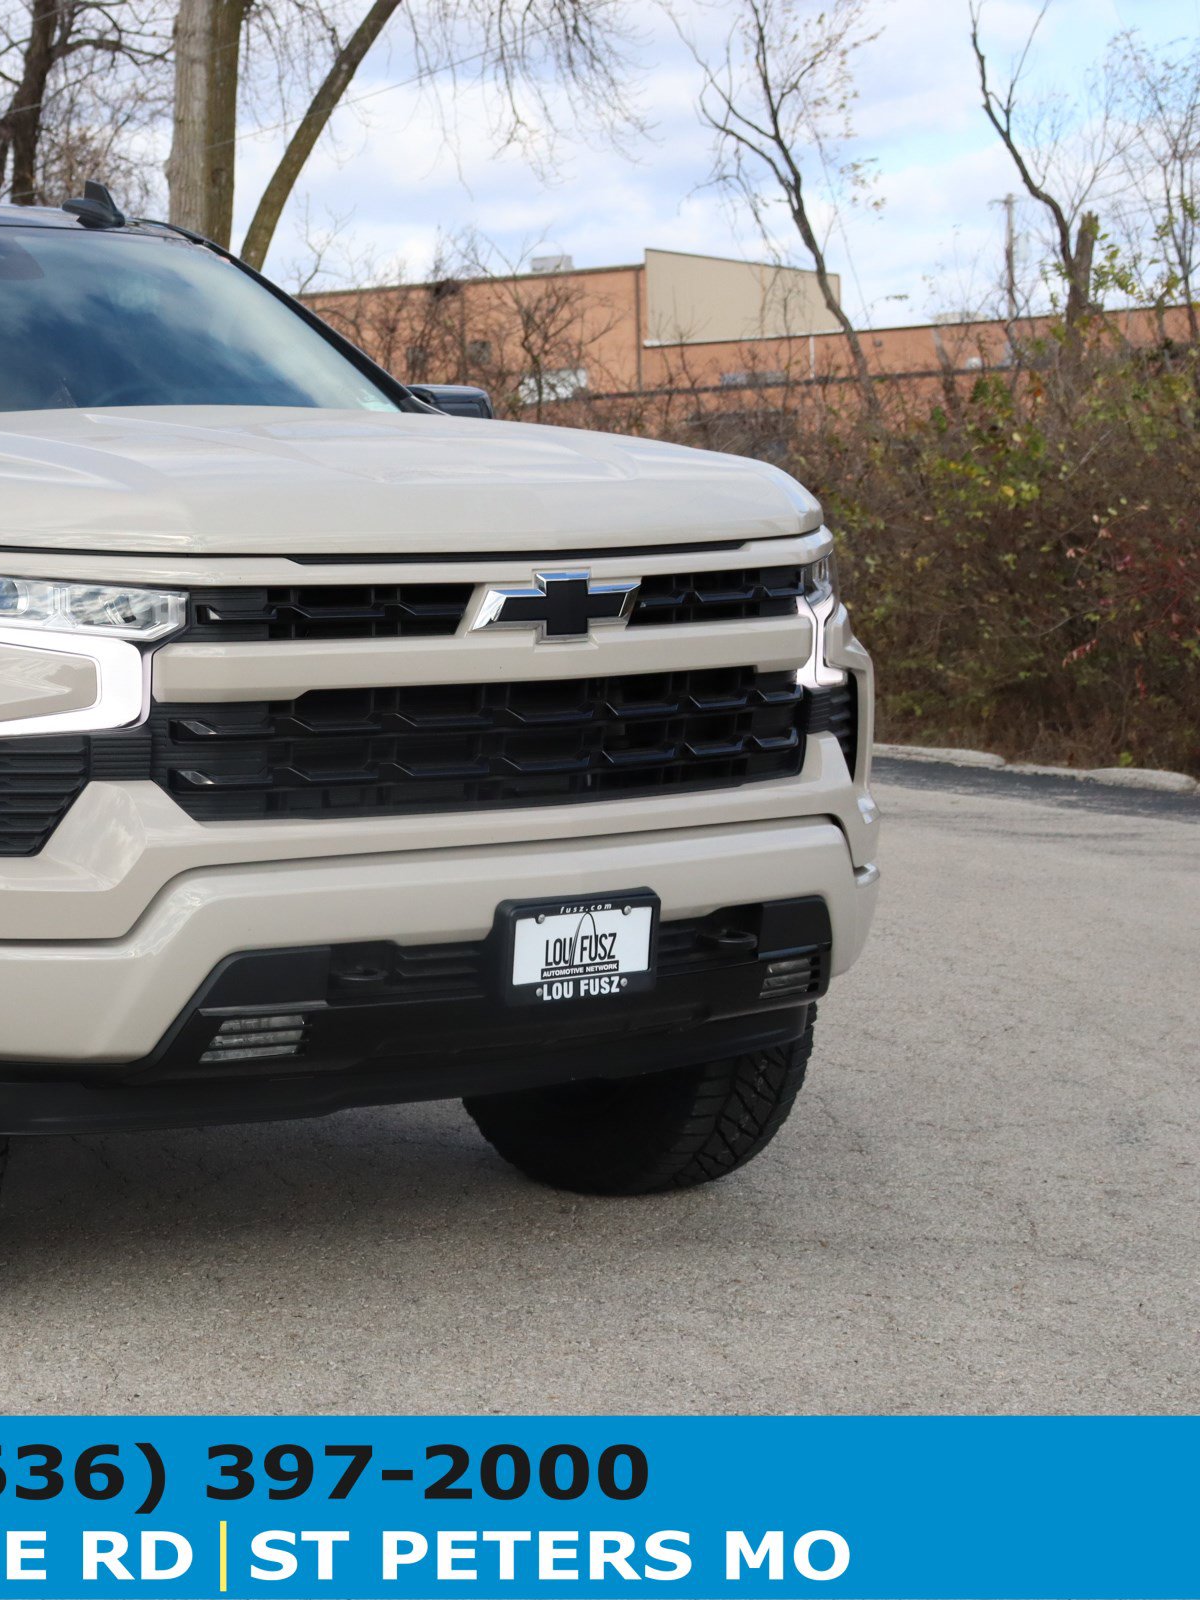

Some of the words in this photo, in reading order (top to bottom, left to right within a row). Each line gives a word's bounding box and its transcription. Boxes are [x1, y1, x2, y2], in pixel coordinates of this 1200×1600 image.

[560, 903, 612, 914] fusz.com
[545, 937, 573, 967] LOU
[580, 932, 617, 963] FUSZ
[542, 967, 584, 978] AUTOMOTIVE
[586, 963, 618, 973] NETWORK
[543, 981, 574, 1001] LOU
[580, 976, 620, 997] FUSZ
